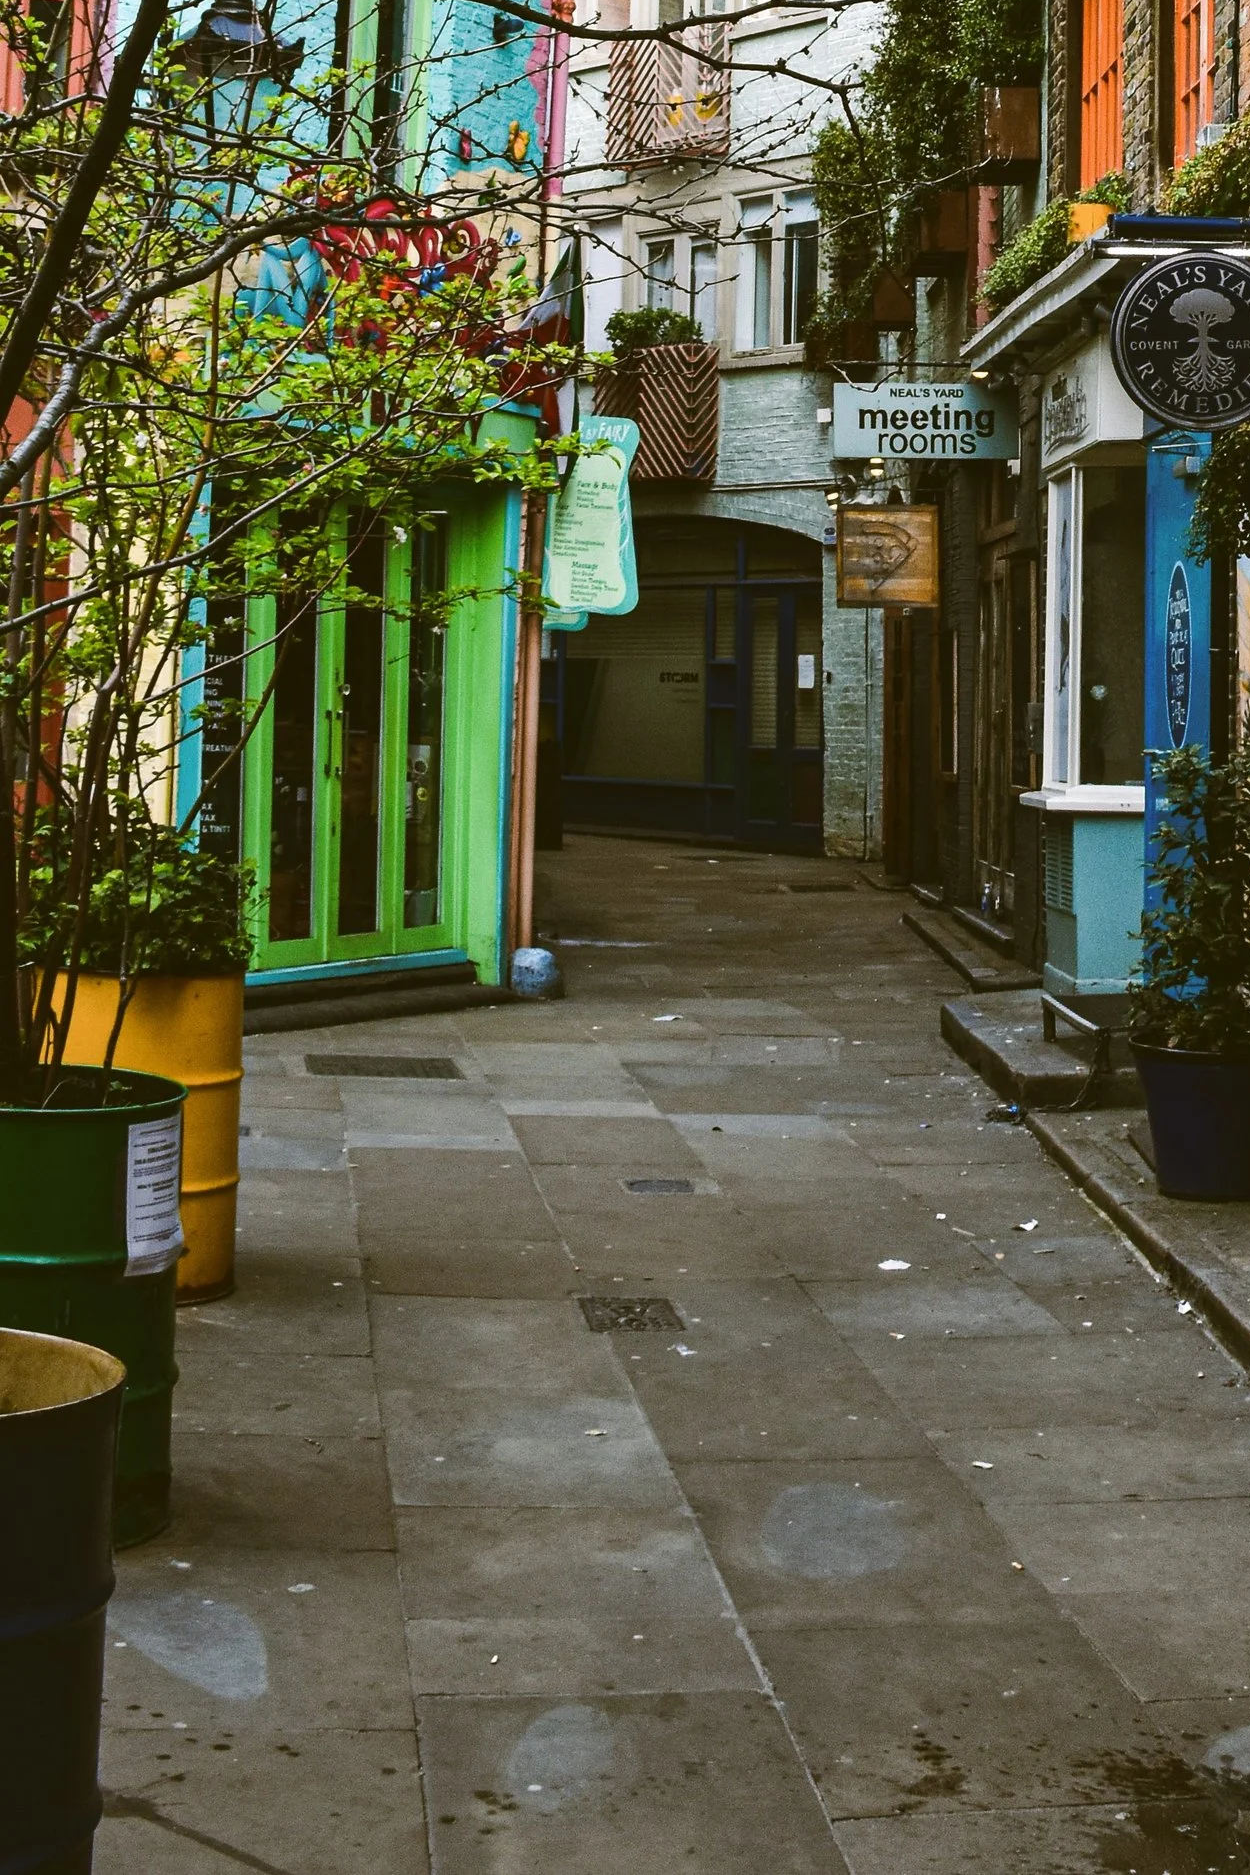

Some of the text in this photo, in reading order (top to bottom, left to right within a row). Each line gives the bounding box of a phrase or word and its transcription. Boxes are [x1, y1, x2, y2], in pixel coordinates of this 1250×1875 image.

[1130, 266, 1206, 332] NEAL'S
[1130, 340, 1179, 351] COVENT
[889, 388, 964, 398] NEAL'S YARD
[858, 403, 995, 438] meeting
[878, 432, 977, 454] rooms
[572, 561, 599, 571] Massage
